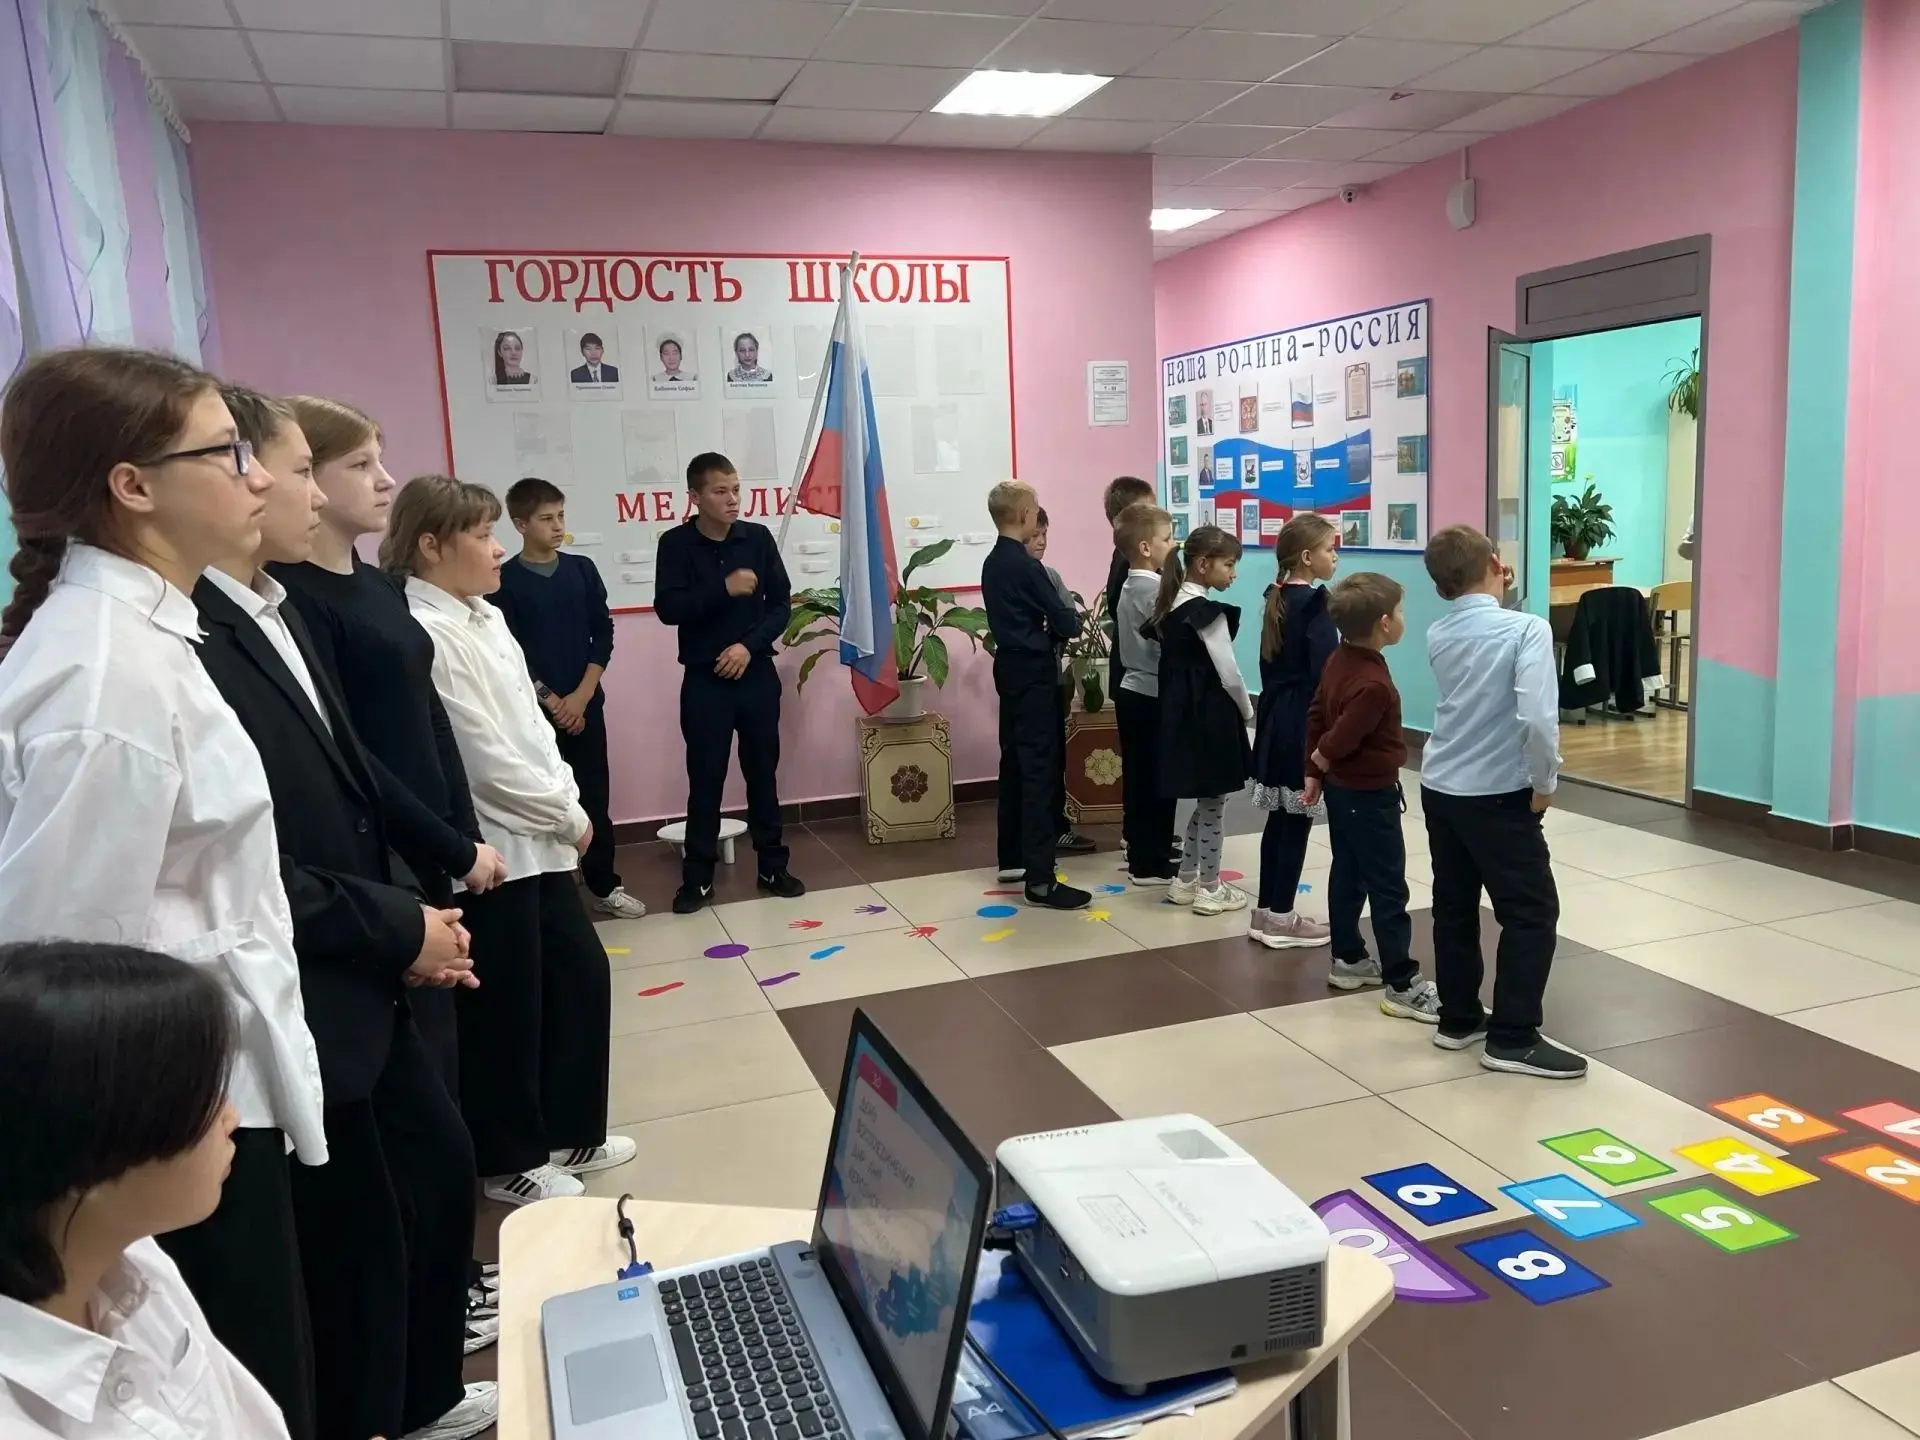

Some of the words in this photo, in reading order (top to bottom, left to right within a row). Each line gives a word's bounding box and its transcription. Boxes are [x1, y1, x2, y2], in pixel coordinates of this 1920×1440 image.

[484, 259, 743, 312] ГОРДОСТЬ
[786, 261, 971, 303] ШКОЛЫ
[1747, 1107, 1805, 1129] 3
[1576, 1144, 1637, 1165] 6
[1712, 1152, 1775, 1175] 4
[1865, 1159, 1920, 1185] 2
[1397, 1184, 1458, 1206] 9
[1532, 1198, 1603, 1221] 7
[1681, 1205, 1755, 1231] 5
[1497, 1250, 1567, 1281] 8
[968, 1402, 1005, 1421] A4
